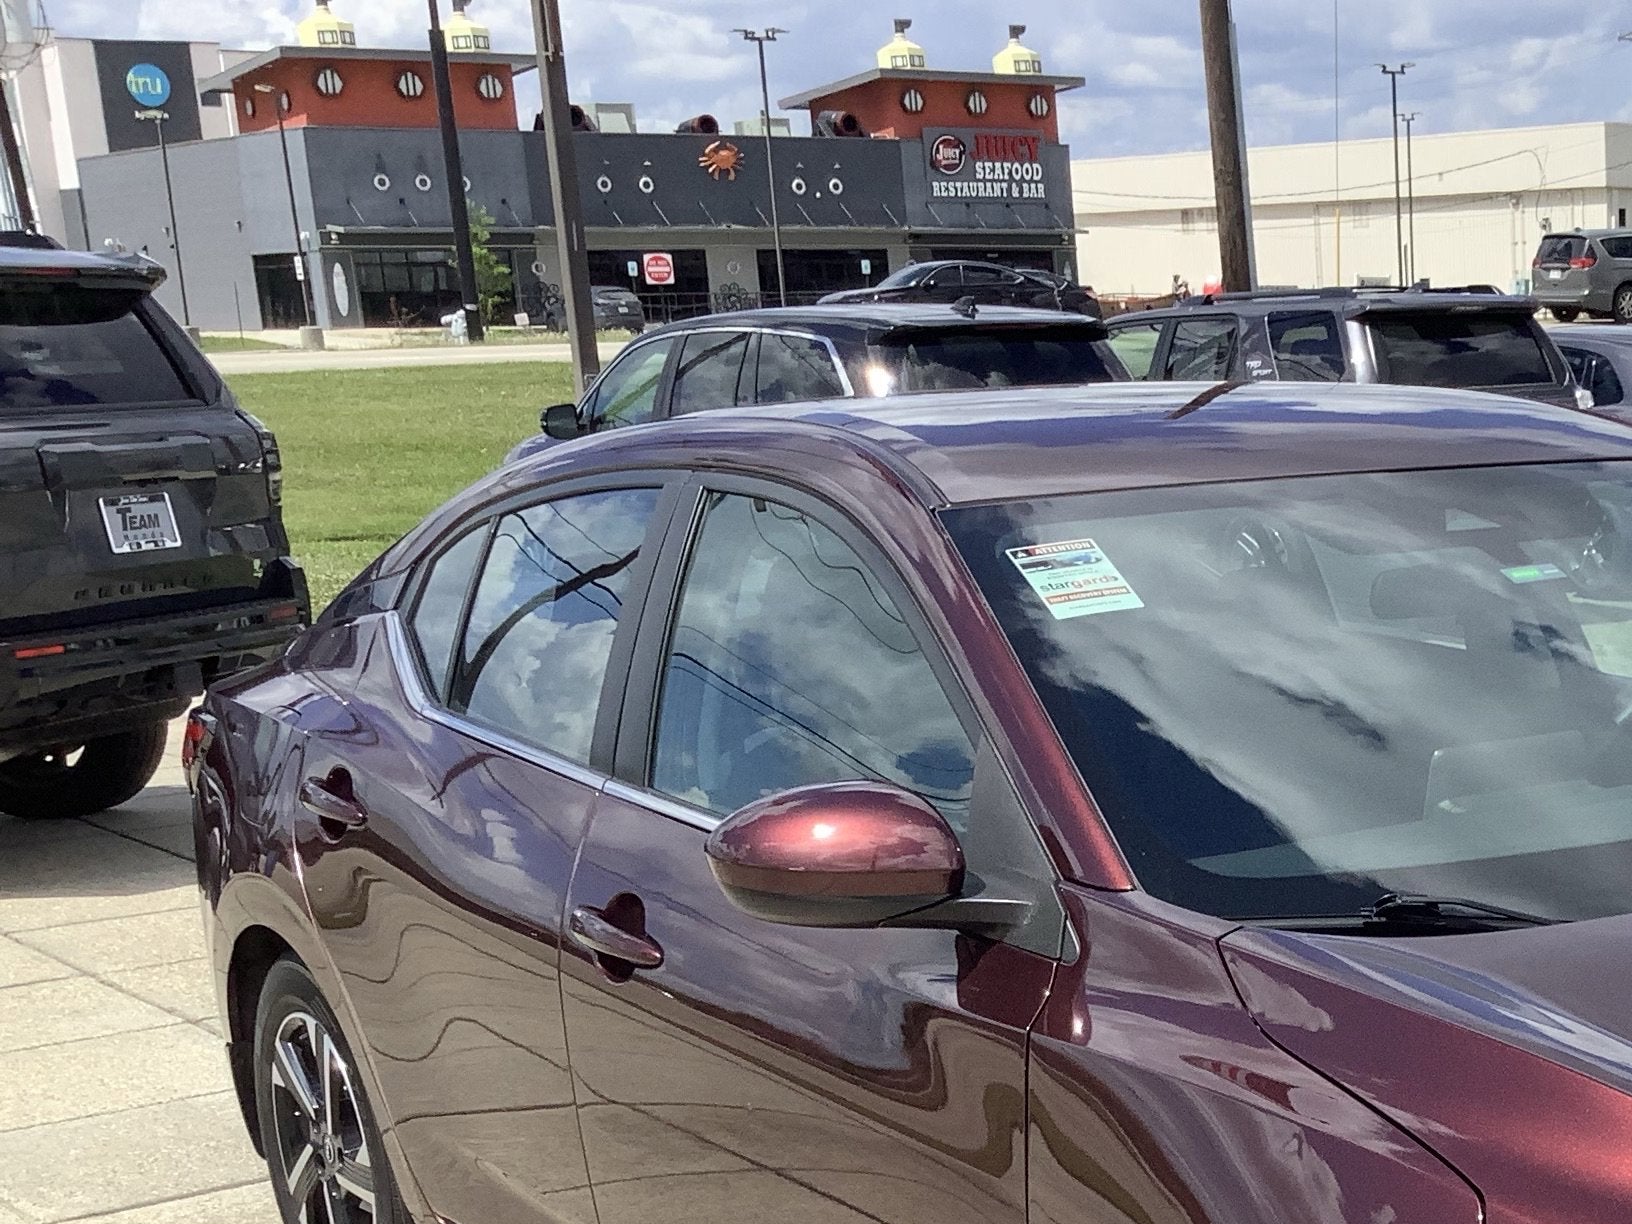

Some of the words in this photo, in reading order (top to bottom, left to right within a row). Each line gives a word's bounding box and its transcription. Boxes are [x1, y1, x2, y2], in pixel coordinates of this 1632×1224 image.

[936, 144, 961, 160] JUICY
[970, 135, 1040, 161] JUICY
[975, 162, 1043, 180] SEAFOOD
[932, 181, 1008, 197] RESTAURANT
[1011, 183, 1020, 198] &
[1022, 183, 1046, 198] BAR
[116, 507, 160, 531] TEAM
[1034, 542, 1092, 555] ATTENTION
